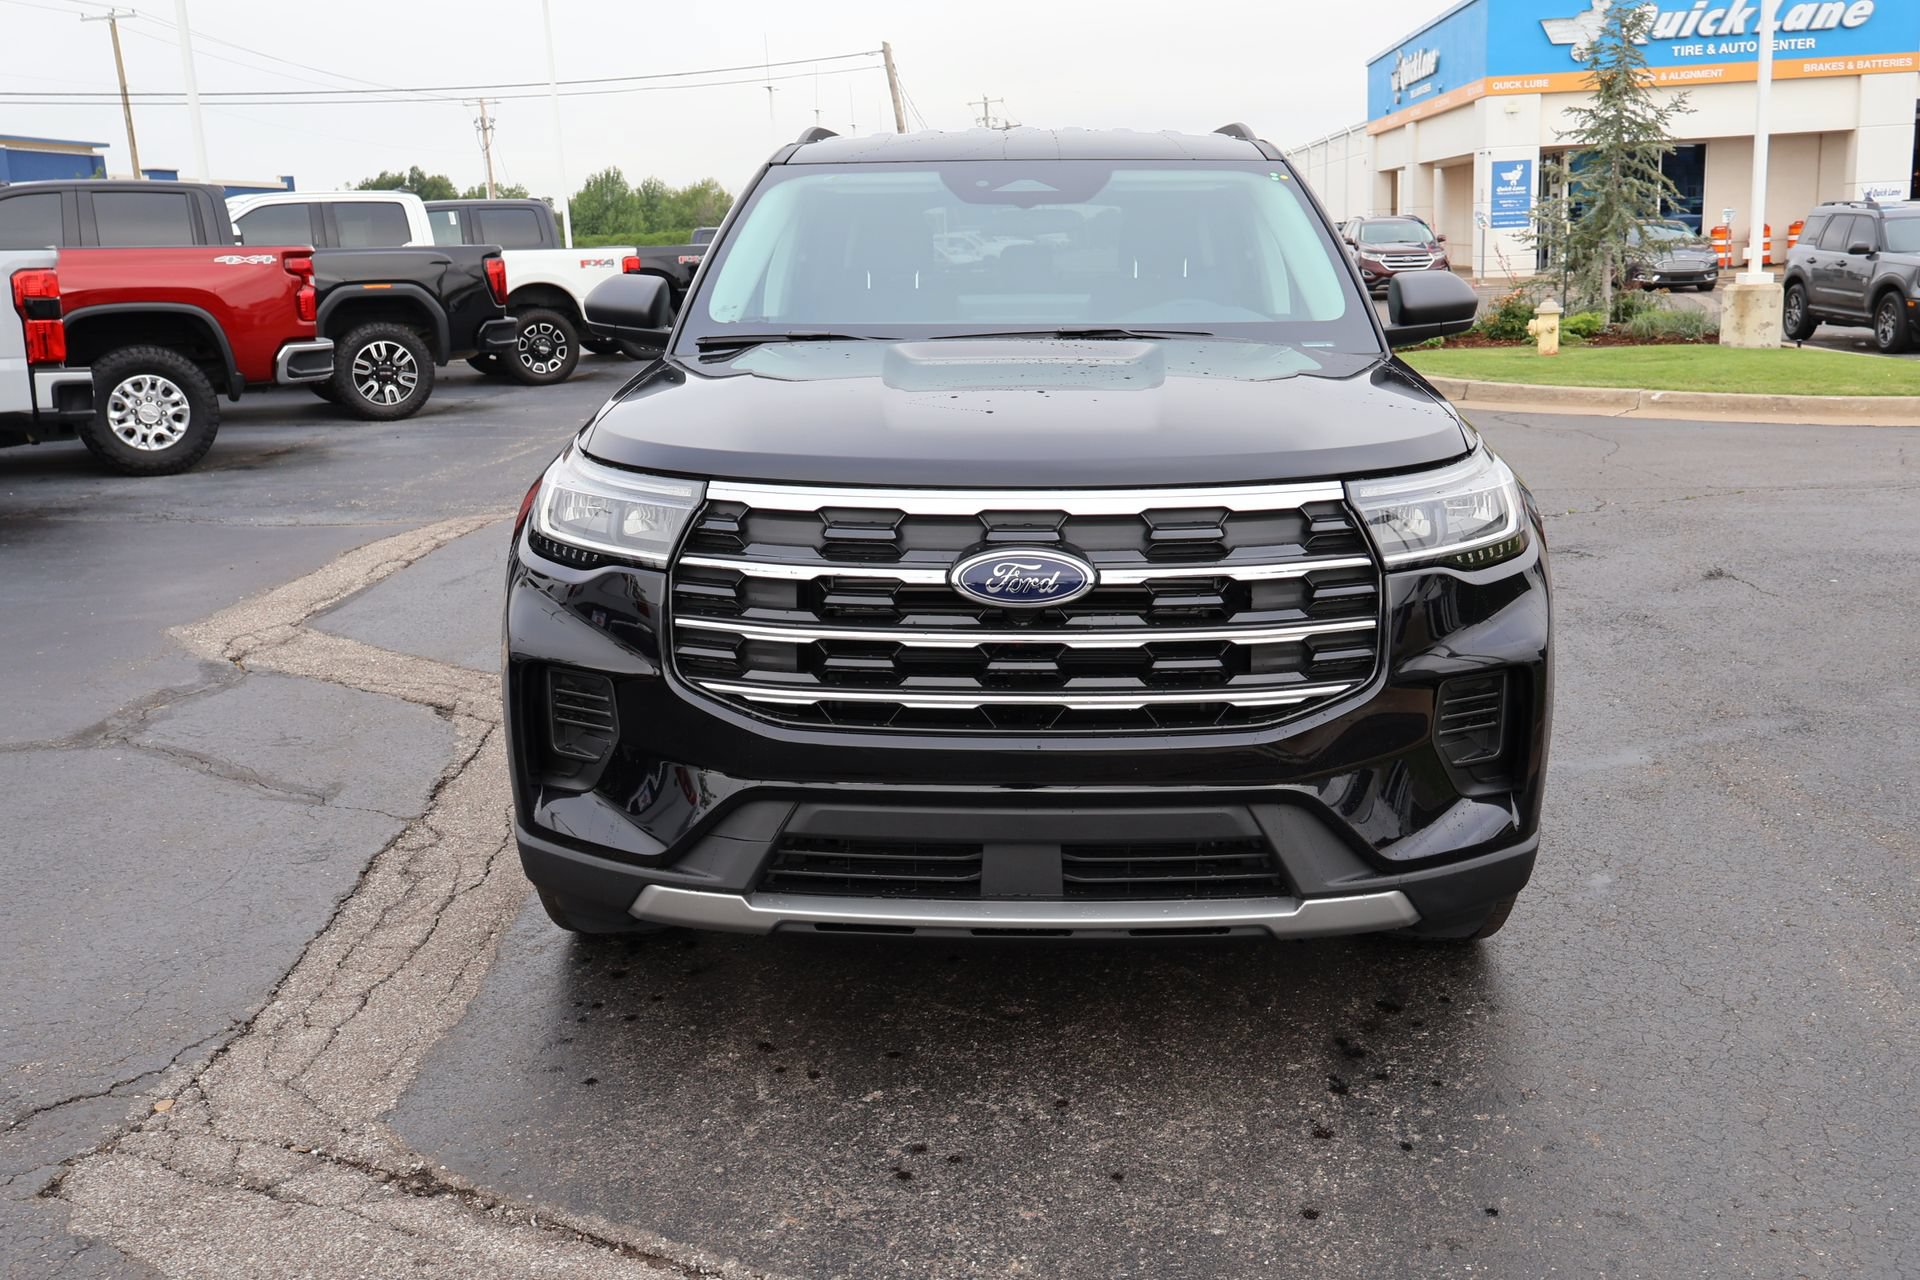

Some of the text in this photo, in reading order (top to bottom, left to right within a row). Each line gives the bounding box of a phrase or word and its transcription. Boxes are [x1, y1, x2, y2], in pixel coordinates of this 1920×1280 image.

[1672, 38, 1816, 57] TIRE & AUTO ENTER
[1803, 58, 1912, 72] BRAKES & BATTERIES
[1669, 69, 1724, 80] ALIGNMENT
[1492, 80, 1522, 90] QUICK
[1524, 79, 1549, 88] LUBE
[580, 258, 615, 269] FX4
[985, 562, 1062, 594] Ford
